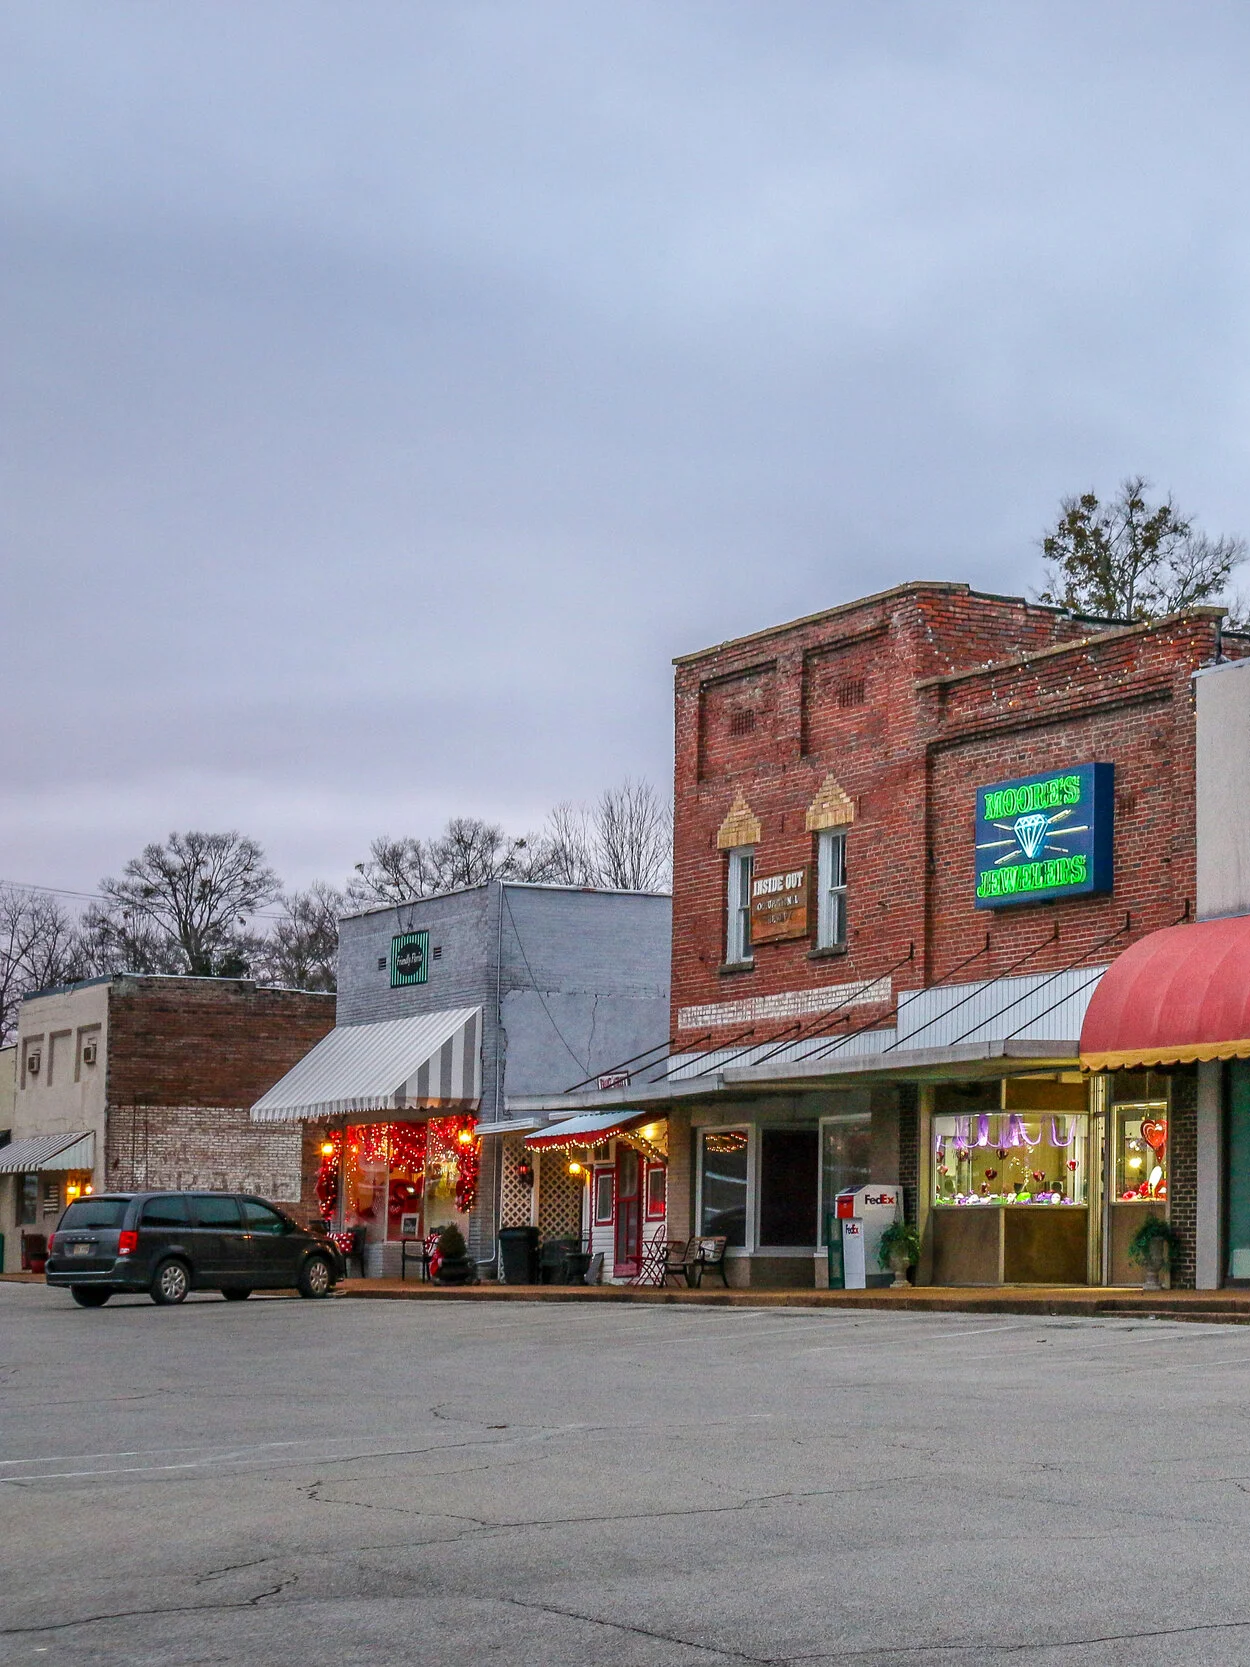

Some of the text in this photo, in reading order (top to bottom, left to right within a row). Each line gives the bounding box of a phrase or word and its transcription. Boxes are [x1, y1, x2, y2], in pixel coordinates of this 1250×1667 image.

[984, 775, 1081, 820] MOORE'S
[753, 871, 803, 896] INSIDE OUT
[976, 854, 1087, 898] JEWELERS
[864, 1193, 895, 1205] FedEx
[845, 1223, 859, 1235] FedEx
